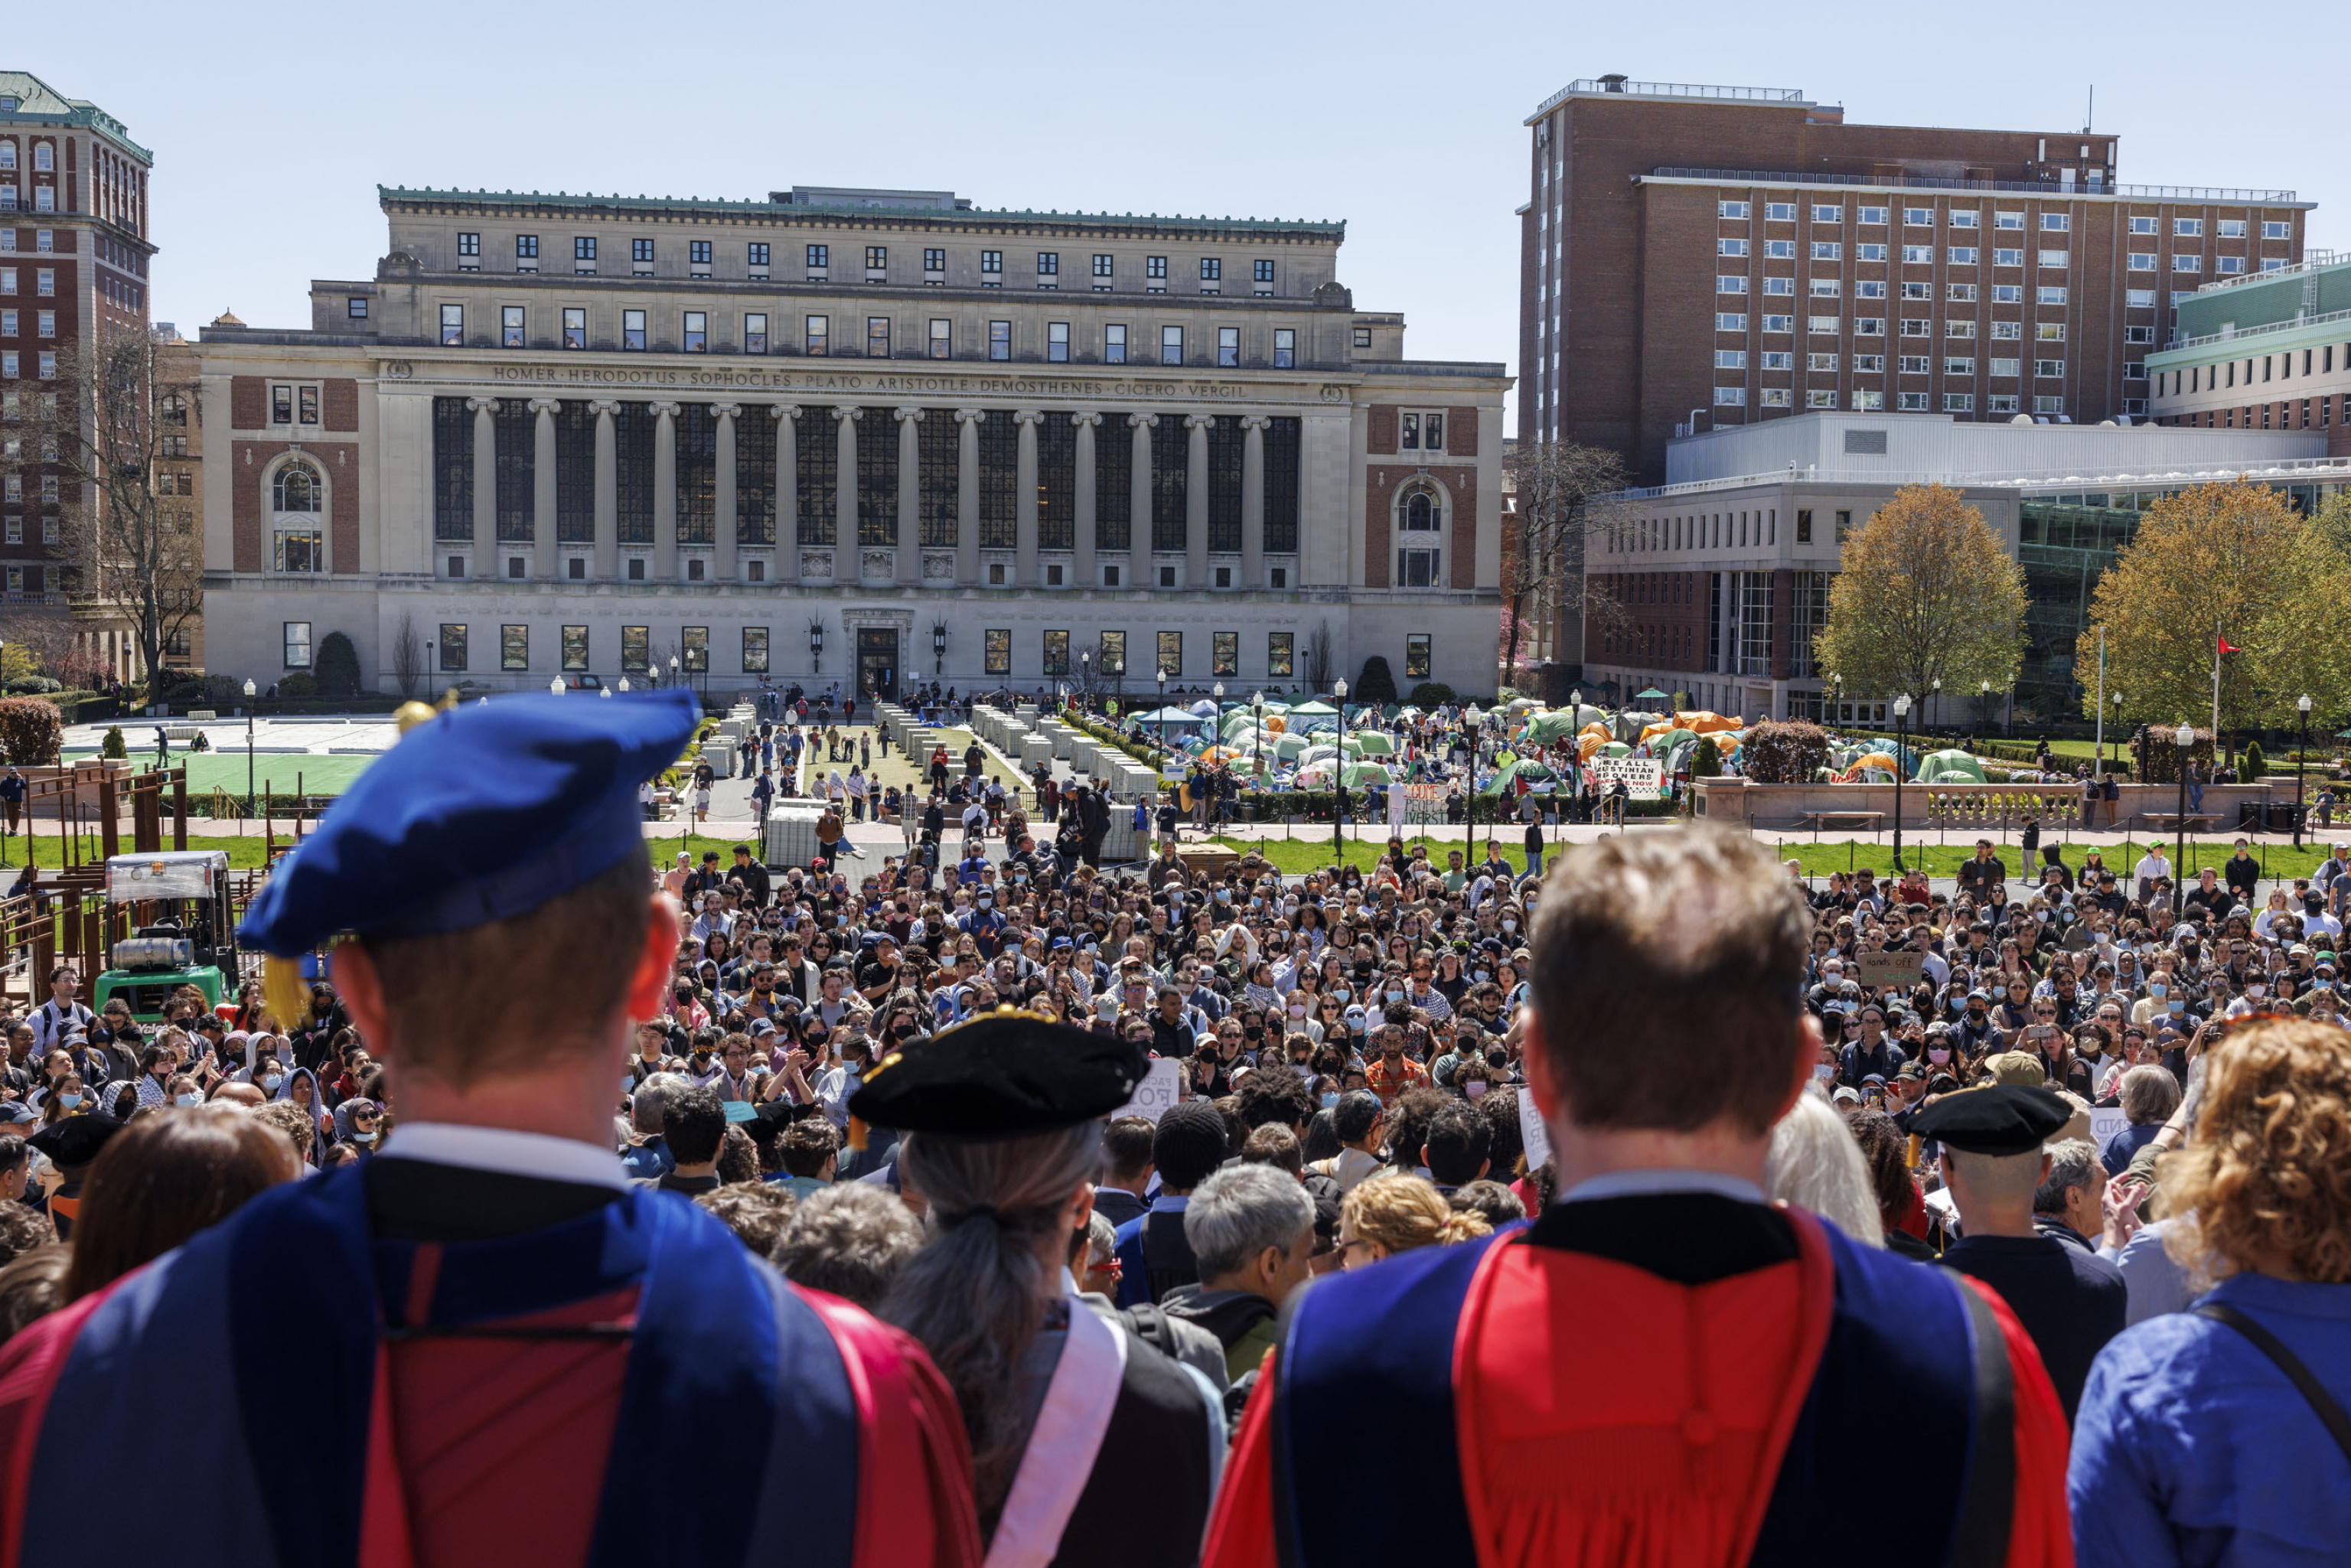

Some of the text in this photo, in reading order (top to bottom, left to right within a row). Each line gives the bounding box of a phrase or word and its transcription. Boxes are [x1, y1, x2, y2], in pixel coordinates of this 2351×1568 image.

[494, 367, 1248, 398] HOMER HERODOTUS SOPHOCLES PLATO ARISTOTLE DEMOSTHENES CICERO VERGIL
[1867, 957, 1891, 967] Hands
